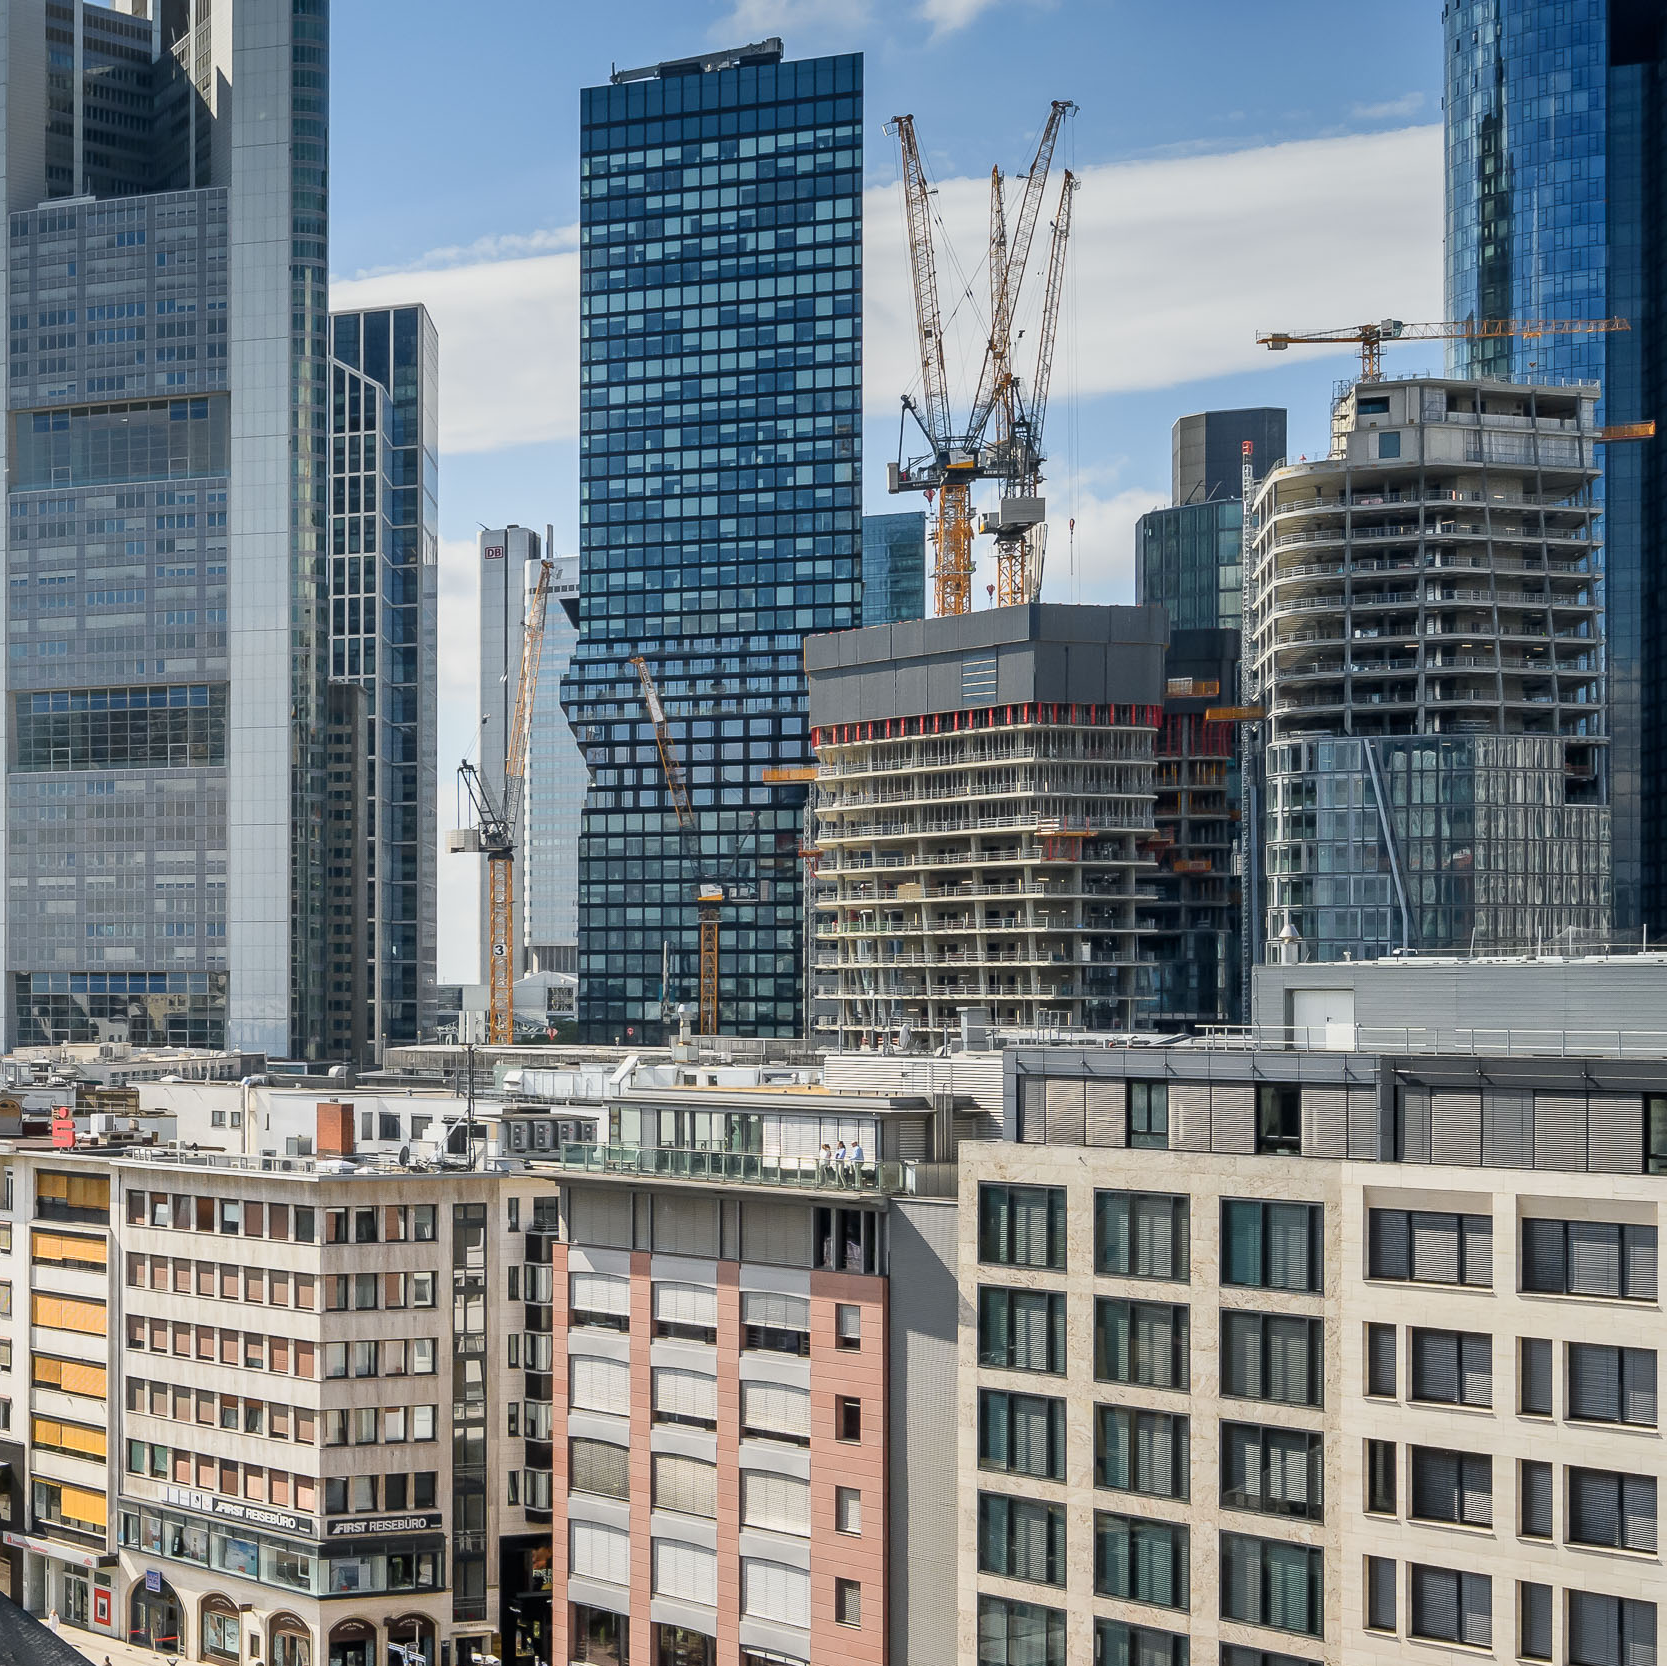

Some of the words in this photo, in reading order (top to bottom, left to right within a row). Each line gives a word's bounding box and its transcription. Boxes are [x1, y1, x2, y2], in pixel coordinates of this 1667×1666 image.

[487, 549, 501, 558] DB
[245, 1506, 296, 1529] REISEBÜRO
[369, 1517, 427, 1532] REISEBÜRO
